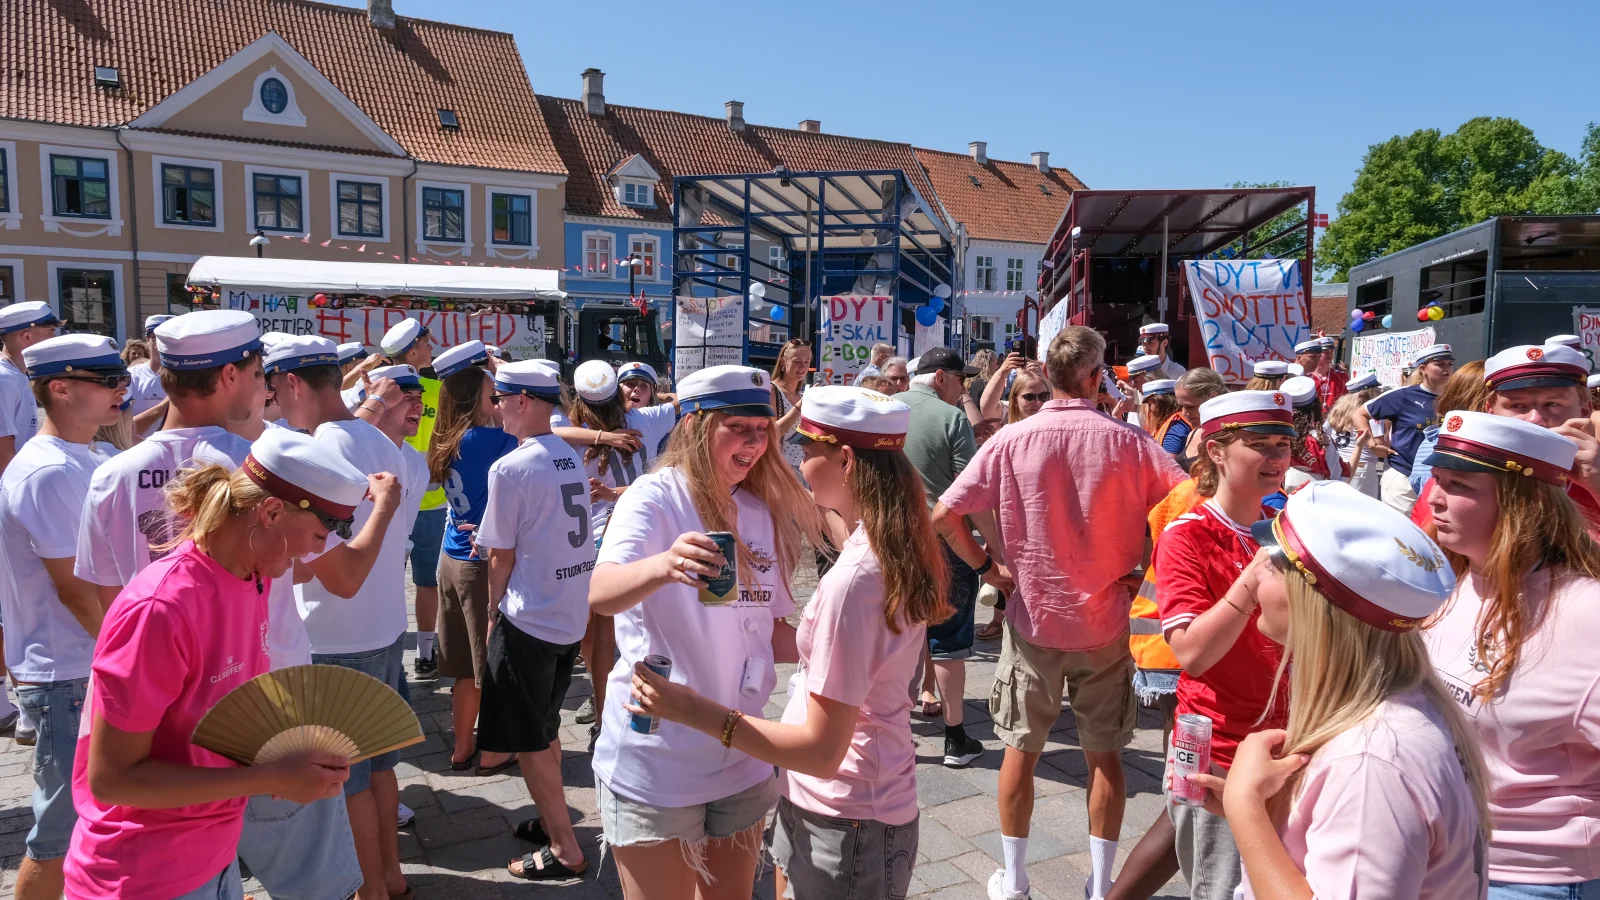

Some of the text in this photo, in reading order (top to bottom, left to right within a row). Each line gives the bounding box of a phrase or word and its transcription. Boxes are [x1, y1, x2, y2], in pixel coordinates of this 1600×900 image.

[1214, 262, 1262, 291] DYT
[689, 298, 725, 310] SWOT
[830, 297, 889, 322] DYT
[420, 312, 516, 347] KILLED
[1204, 319, 1224, 350] 2
[552, 457, 576, 471] PORS
[560, 481, 588, 549] 5
[1175, 749, 1195, 764] ICE
